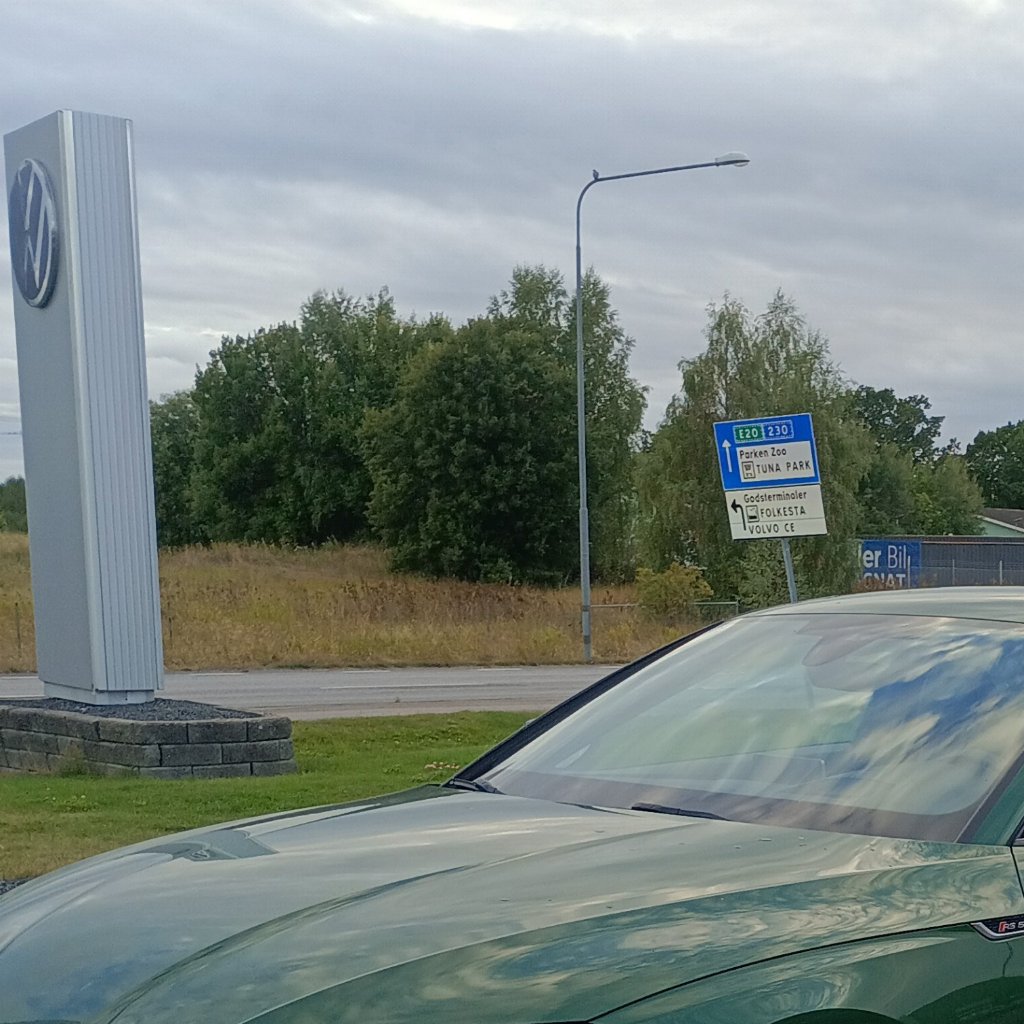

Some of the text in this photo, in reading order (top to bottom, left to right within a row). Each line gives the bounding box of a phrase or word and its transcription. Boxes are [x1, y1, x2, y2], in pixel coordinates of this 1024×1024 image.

[738, 428, 759, 439] E20
[767, 425, 789, 437] 230
[739, 447, 787, 459] Parken Zoo
[756, 460, 811, 473] TUNA PARK
[744, 490, 807, 503] Godsterminaler
[760, 506, 806, 518] FOLKESTA
[748, 522, 795, 534] VOLVO CE
[887, 544, 907, 569] Bil
